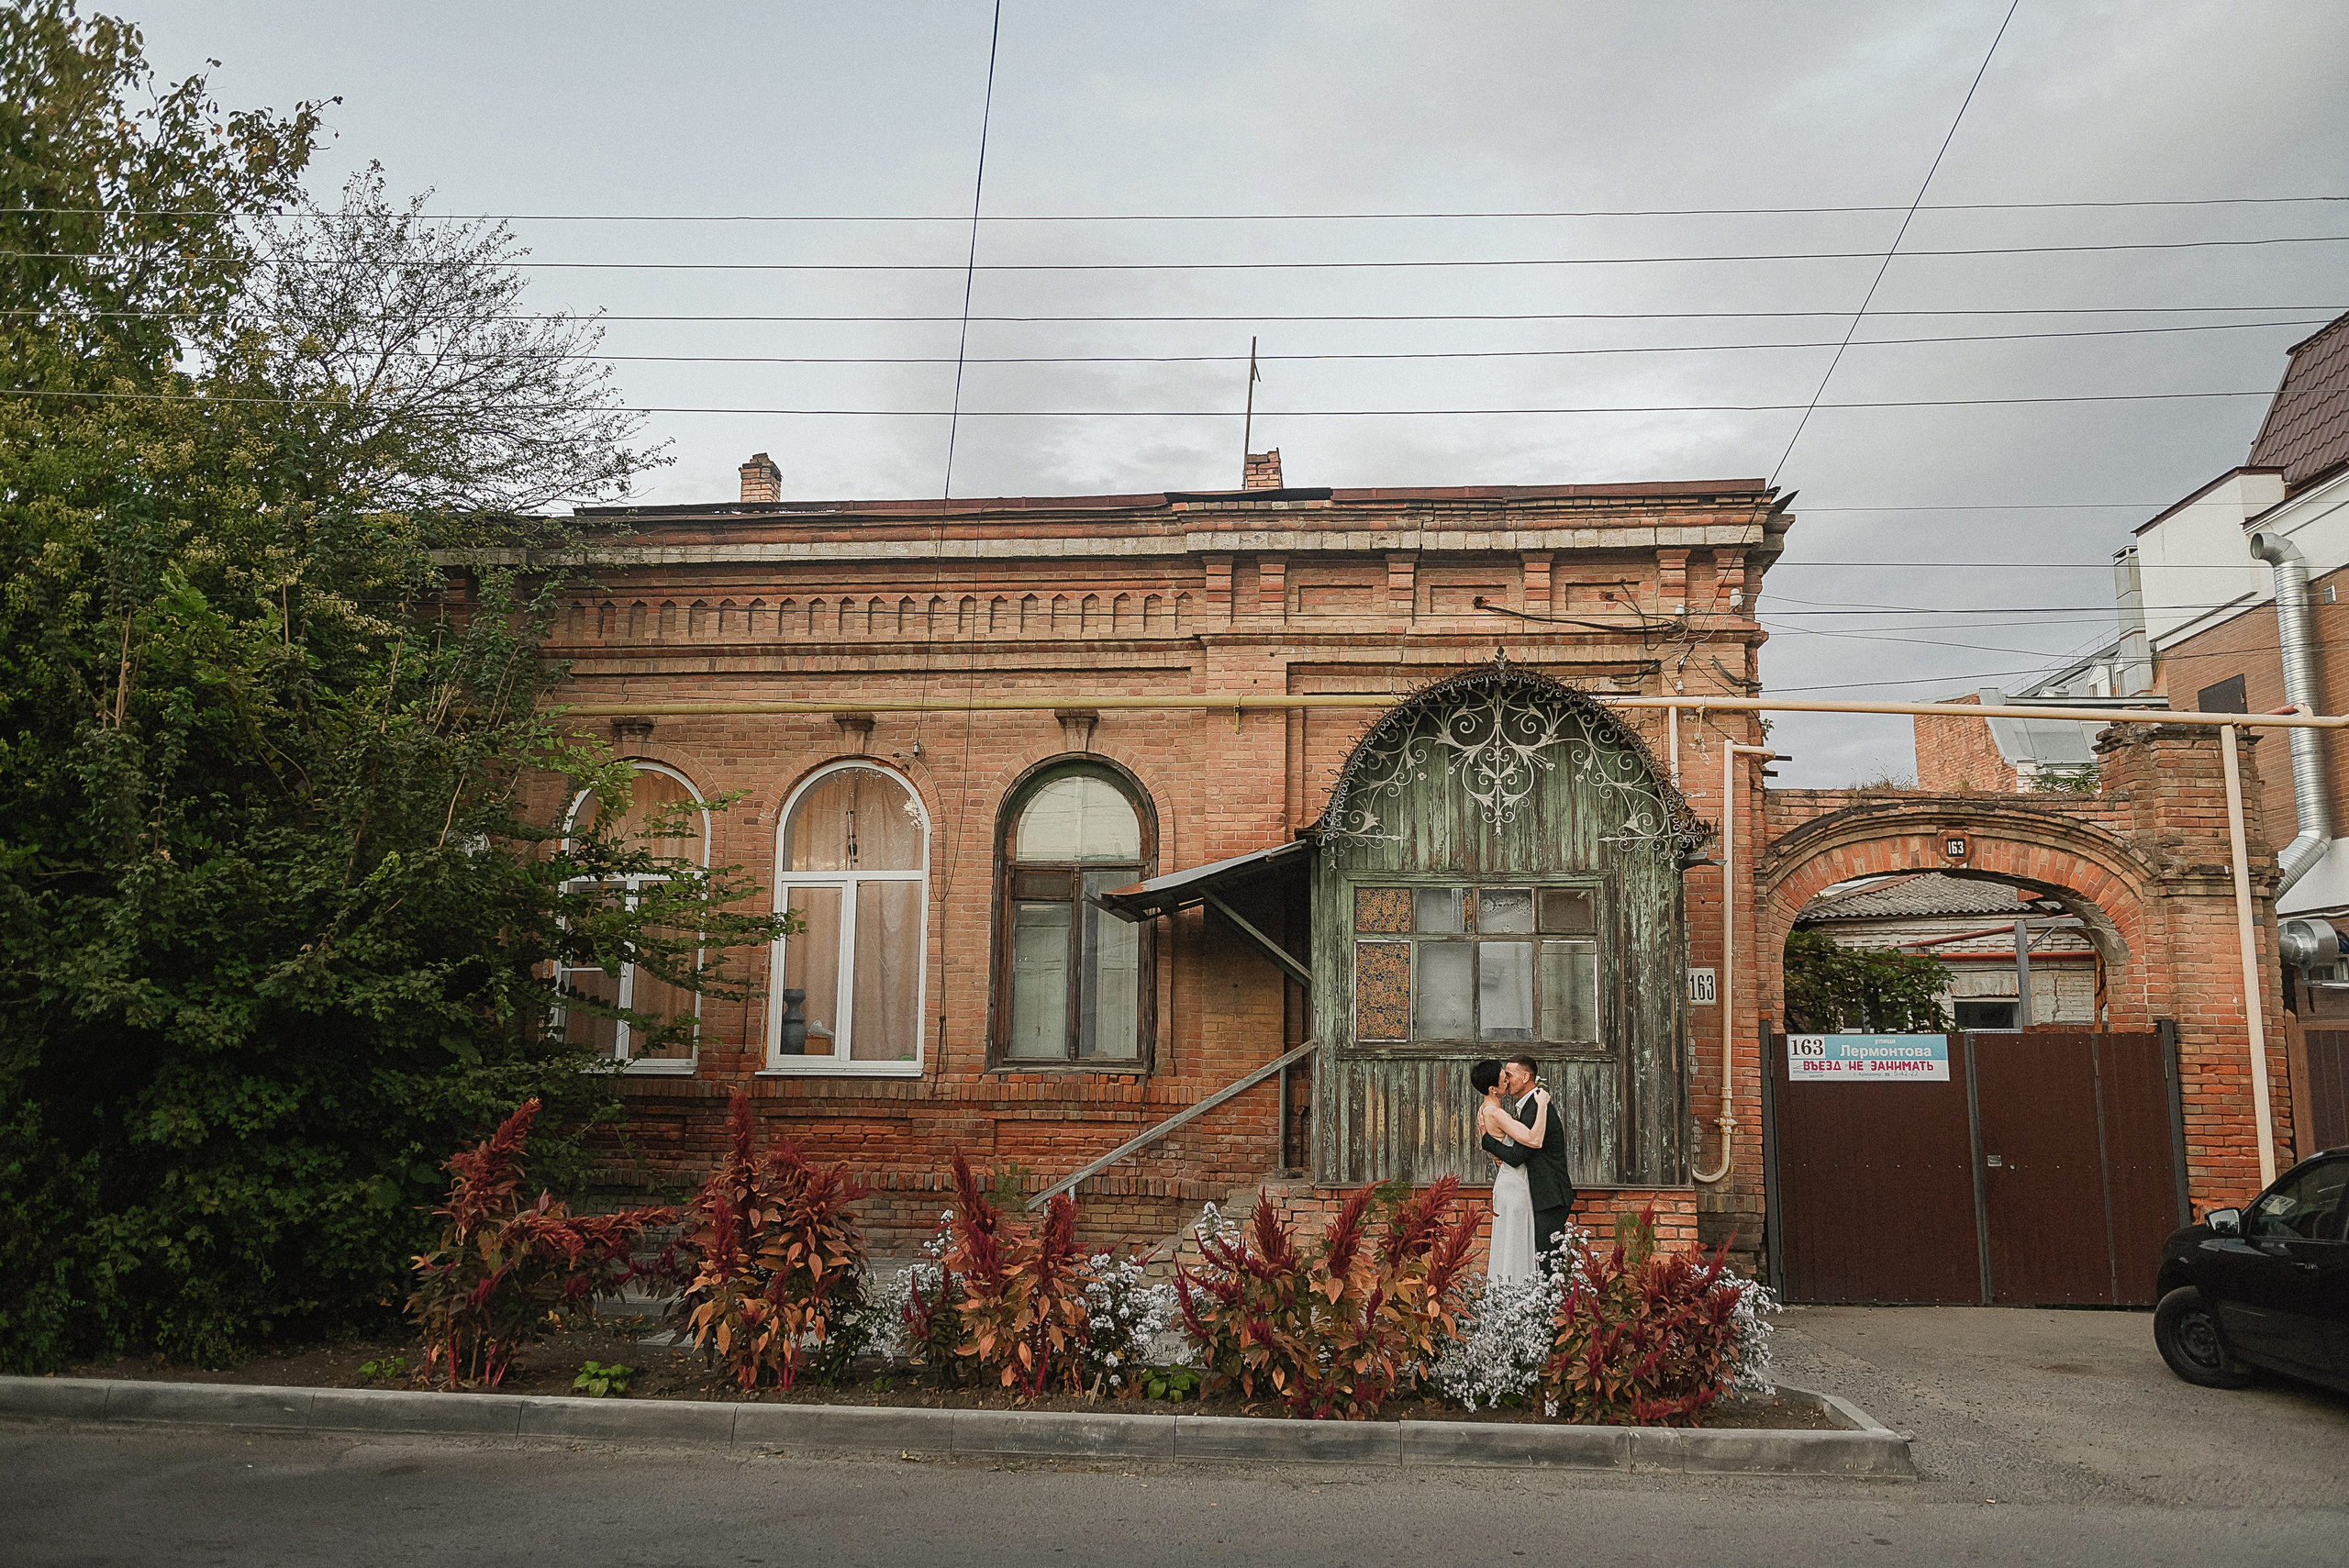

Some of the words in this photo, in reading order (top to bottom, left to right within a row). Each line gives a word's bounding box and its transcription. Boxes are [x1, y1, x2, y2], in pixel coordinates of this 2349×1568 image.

[1947, 841, 1965, 854] 163
[1689, 974, 1714, 1000] 163
[1790, 1039, 1824, 1056] 163
[1840, 1044, 1932, 1059] Лермонтова
[1803, 1060, 1842, 1071] ВЪЕЗД
[1848, 1060, 1864, 1071] НЕ
[1870, 1061, 1934, 1071] ЗАНИМАТЬ
